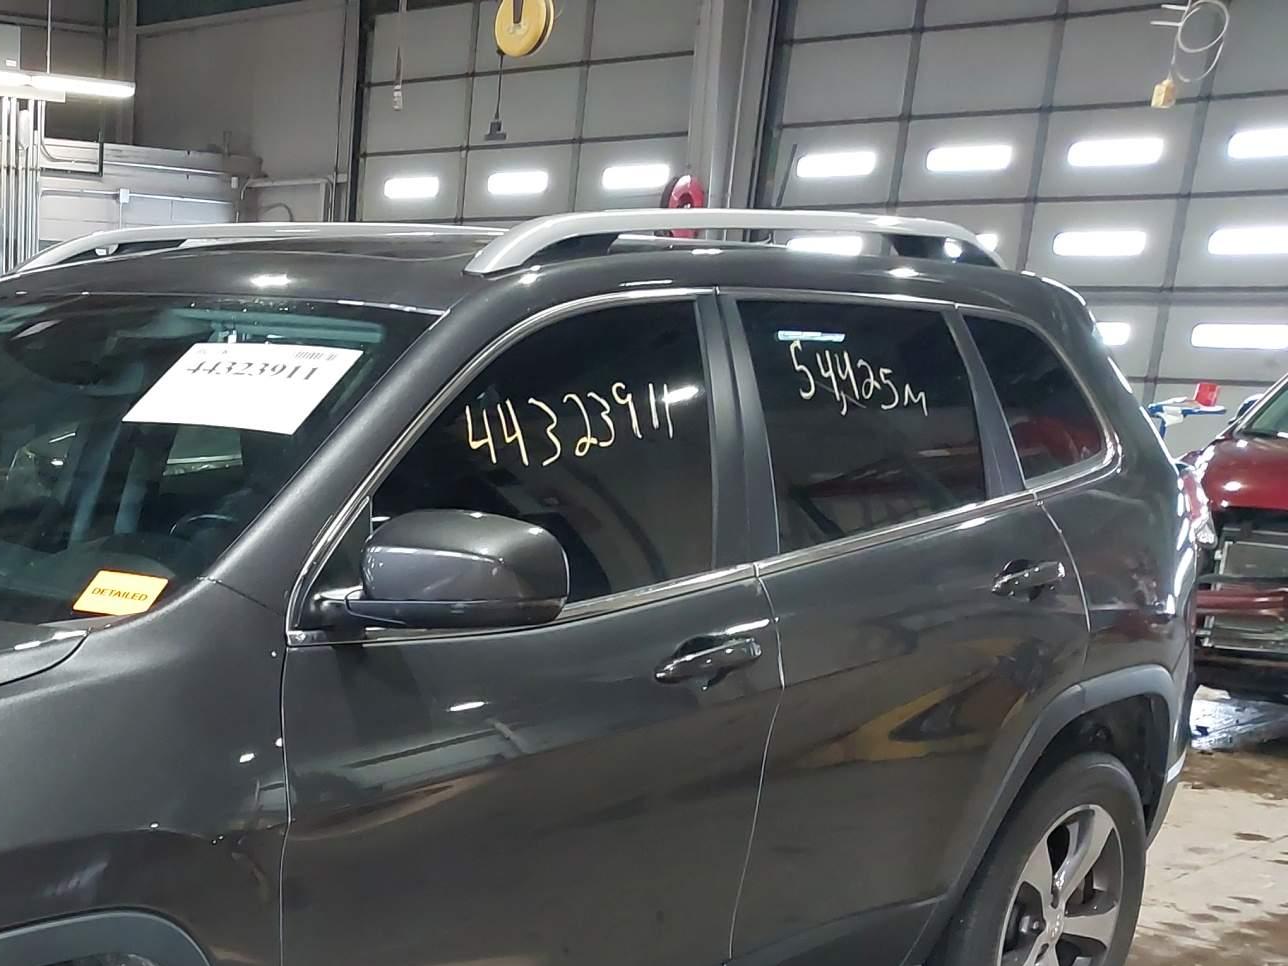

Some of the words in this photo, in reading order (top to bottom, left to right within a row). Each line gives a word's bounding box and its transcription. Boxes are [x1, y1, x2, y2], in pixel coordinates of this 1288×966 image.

[187, 361, 320, 381] 44323911
[465, 381, 674, 467] 44323911
[91, 587, 148, 601] DETAILED
